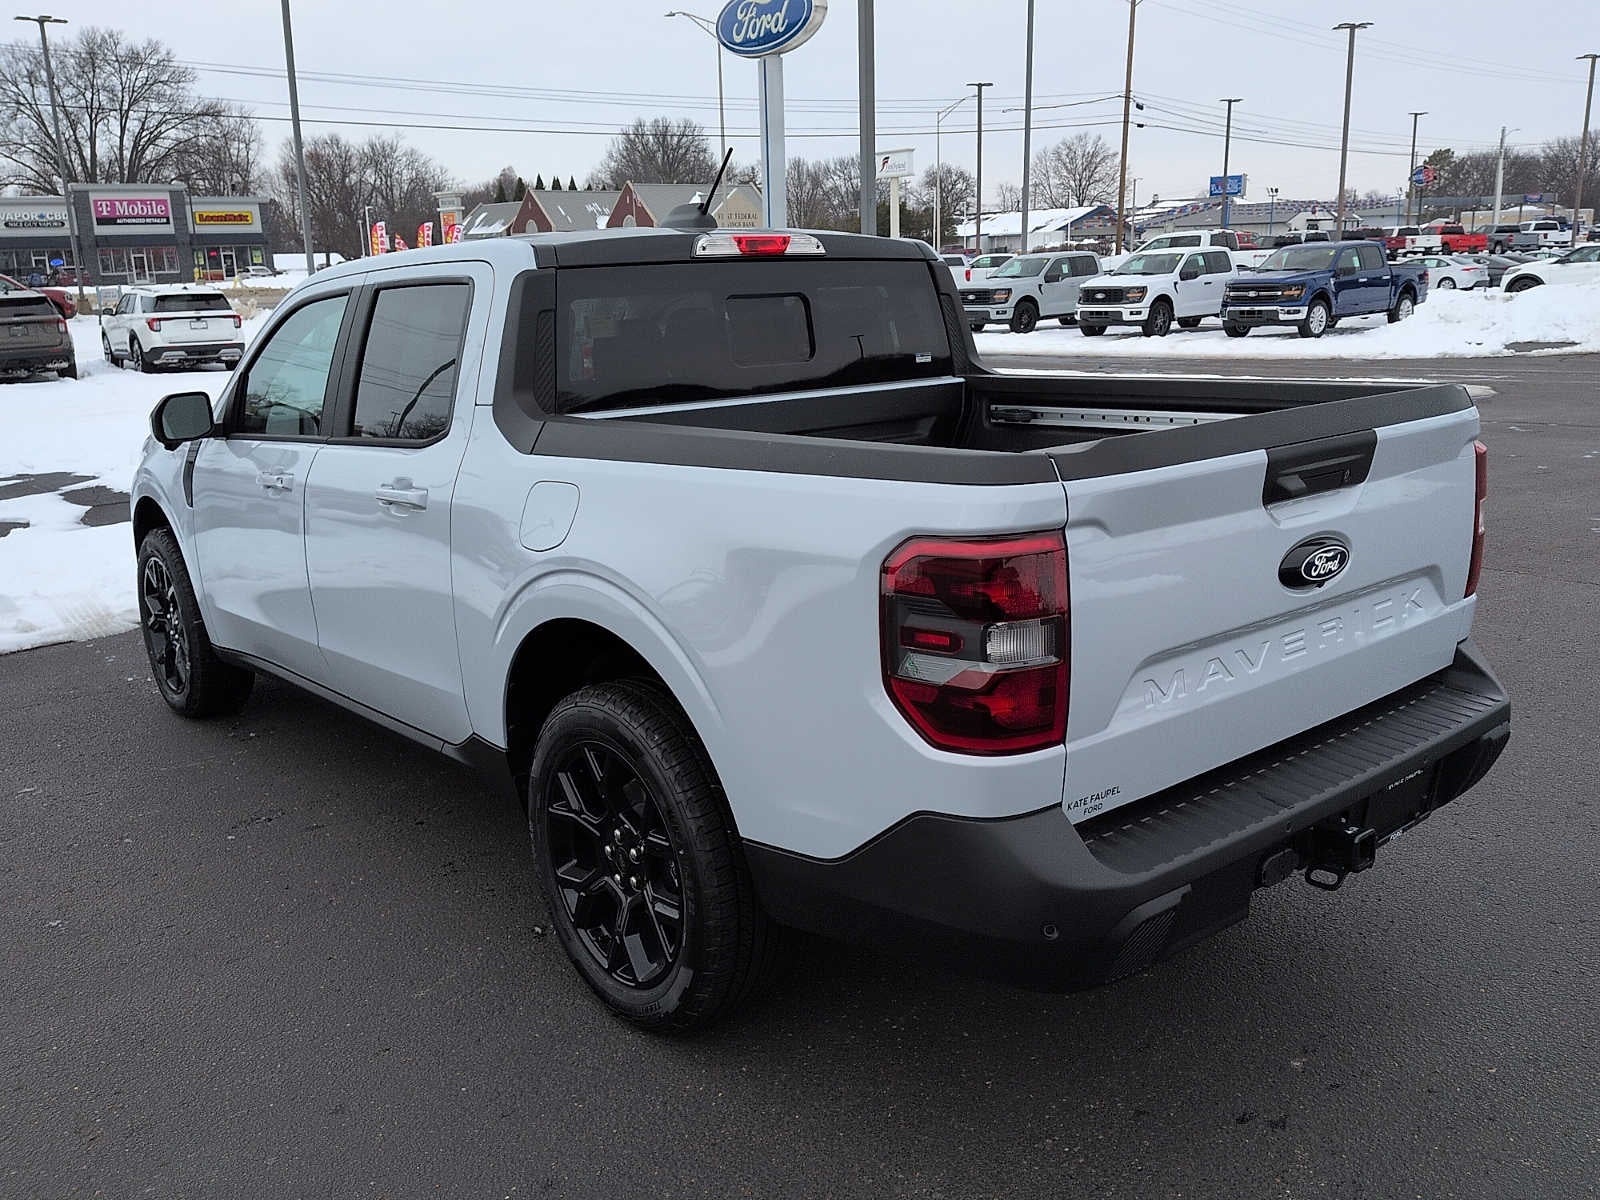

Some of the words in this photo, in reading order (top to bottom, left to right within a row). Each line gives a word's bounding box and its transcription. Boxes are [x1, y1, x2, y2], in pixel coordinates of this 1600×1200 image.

[733, 0, 788, 43] Ford
[0, 211, 39, 221] VAPOR
[114, 201, 166, 216] Mobile
[1311, 551, 1341, 577] Ford
[1143, 587, 1425, 709] MAVERICK
[1067, 796, 1089, 811] KATE
[1090, 786, 1121, 803] FAUPEL
[1083, 803, 1103, 815] FORD
